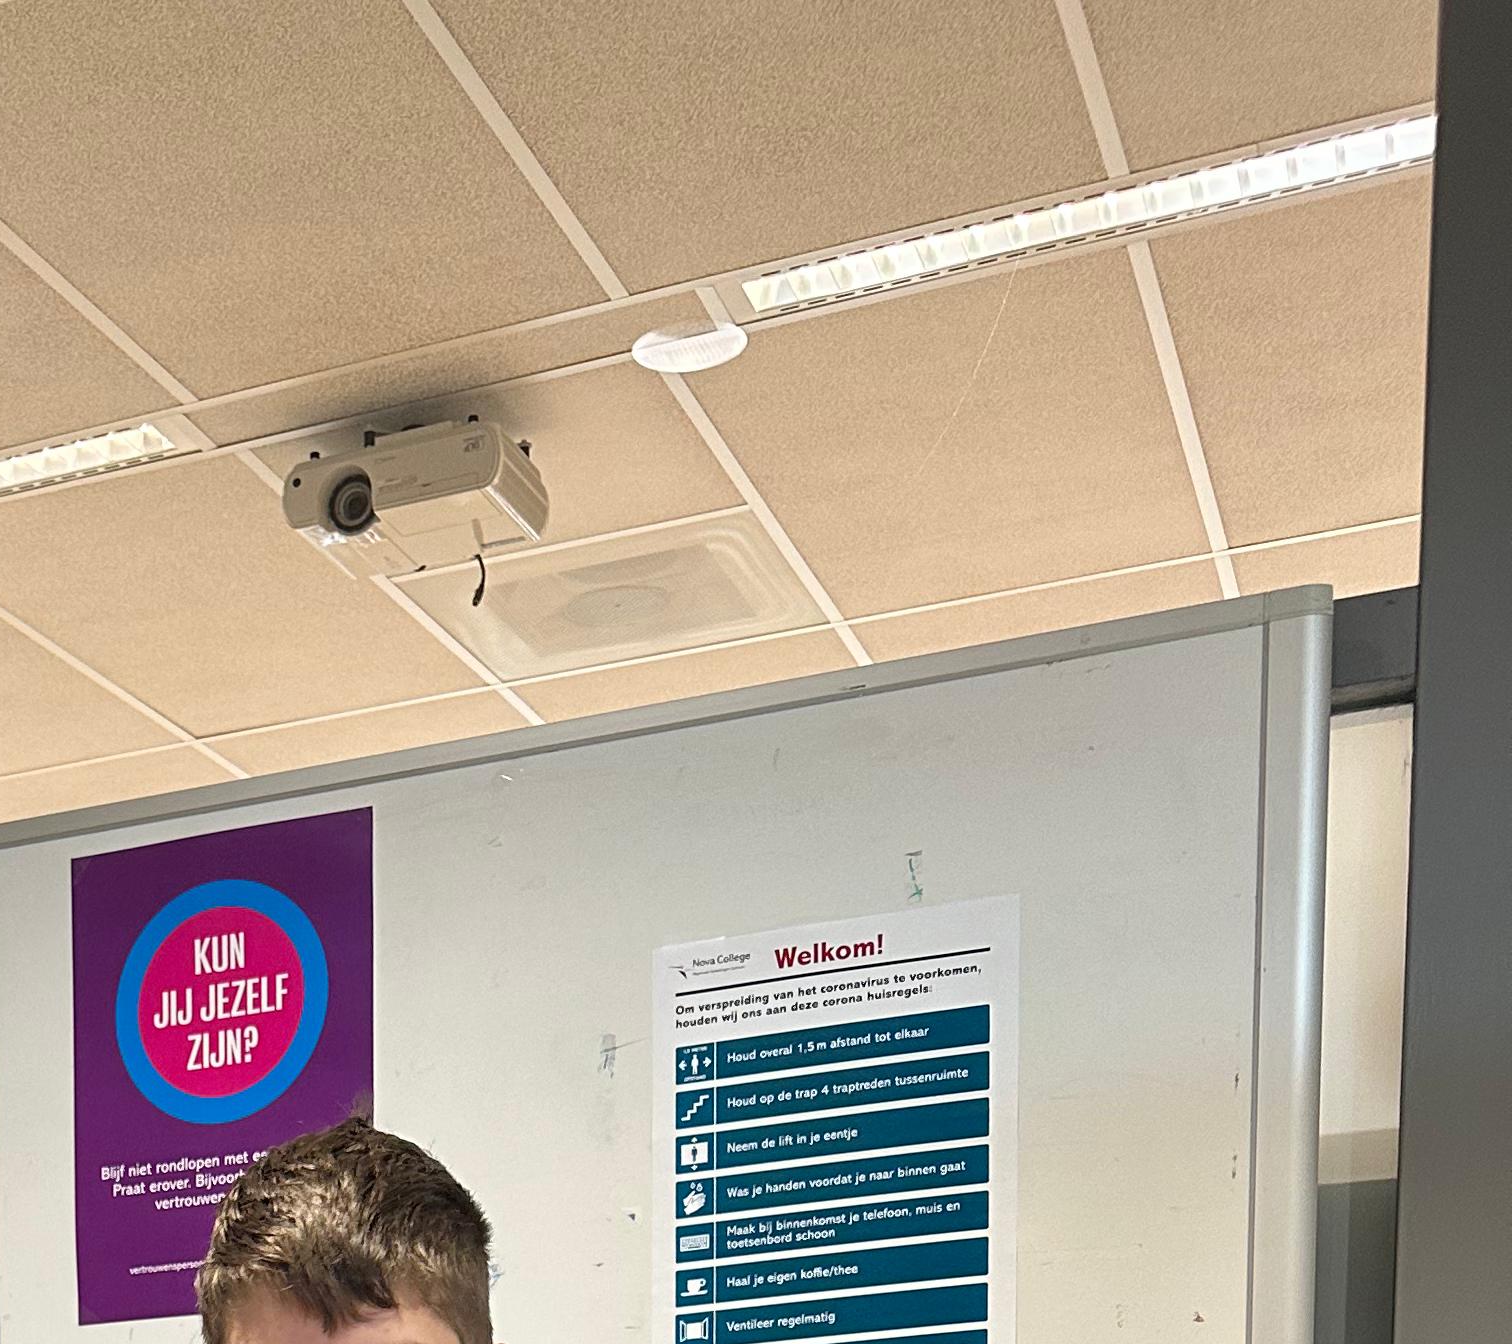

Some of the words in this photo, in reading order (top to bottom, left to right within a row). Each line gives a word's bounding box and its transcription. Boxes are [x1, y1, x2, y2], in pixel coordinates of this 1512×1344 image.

[193, 932, 245, 976] KUN
[775, 934, 883, 969] Welkom!
[153, 988, 193, 1029] JIJ
[200, 974, 289, 1022] JEZELF
[676, 1005, 695, 1016] Om
[699, 994, 769, 1012] verspreiding
[773, 991, 794, 1000] van
[798, 985, 817, 996] het
[821, 976, 889, 993] coronavirus
[894, 974, 906, 984] te
[910, 964, 981, 982] voorkomen,
[676, 1014, 718, 1028] houden
[722, 1010, 738, 1023] wij
[742, 1009, 762, 1019] ons
[766, 1005, 787, 1016] aan
[791, 1000, 819, 1013] deze
[823, 994, 863, 1007] corona
[187, 1026, 259, 1071] ZIJN?
[727, 1050, 756, 1063] Houd
[760, 1045, 793, 1059] overal
[830, 1033, 871, 1050] afstand
[875, 1032, 891, 1043] tot
[895, 1026, 929, 1041] elkaar
[727, 1095, 756, 1108] Houd
[760, 1093, 774, 1105] op
[778, 1090, 790, 1101] de
[795, 1087, 817, 1100] trap
[822, 1086, 829, 1096] 4
[833, 1077, 891, 1095] traptreden
[895, 1067, 968, 1085] tussenruimte
[727, 1141, 757, 1154] Neem
[762, 1137, 775, 1149] de
[779, 1134, 793, 1146] lift
[797, 1133, 807, 1143] in
[810, 1132, 821, 1145] je
[825, 1128, 858, 1143] eentje
[101, 1165, 125, 1181] Blijf
[128, 1163, 152, 1177] niet
[156, 1157, 220, 1175] rondlopen
[224, 1151, 248, 1165] met
[727, 1187, 749, 1198] Was
[752, 1186, 763, 1198] je
[766, 1180, 806, 1193] handen
[809, 1174, 852, 1188] voordat
[855, 1173, 866, 1185] je
[869, 1169, 894, 1180] naar
[898, 1164, 936, 1177] binnen
[940, 1161, 966, 1175] gaat
[113, 1182, 146, 1197] Praat
[149, 1178, 192, 1193] erover.
[726, 1318, 774, 1332] Ventileer
[777, 1311, 835, 1329] regelmatig
